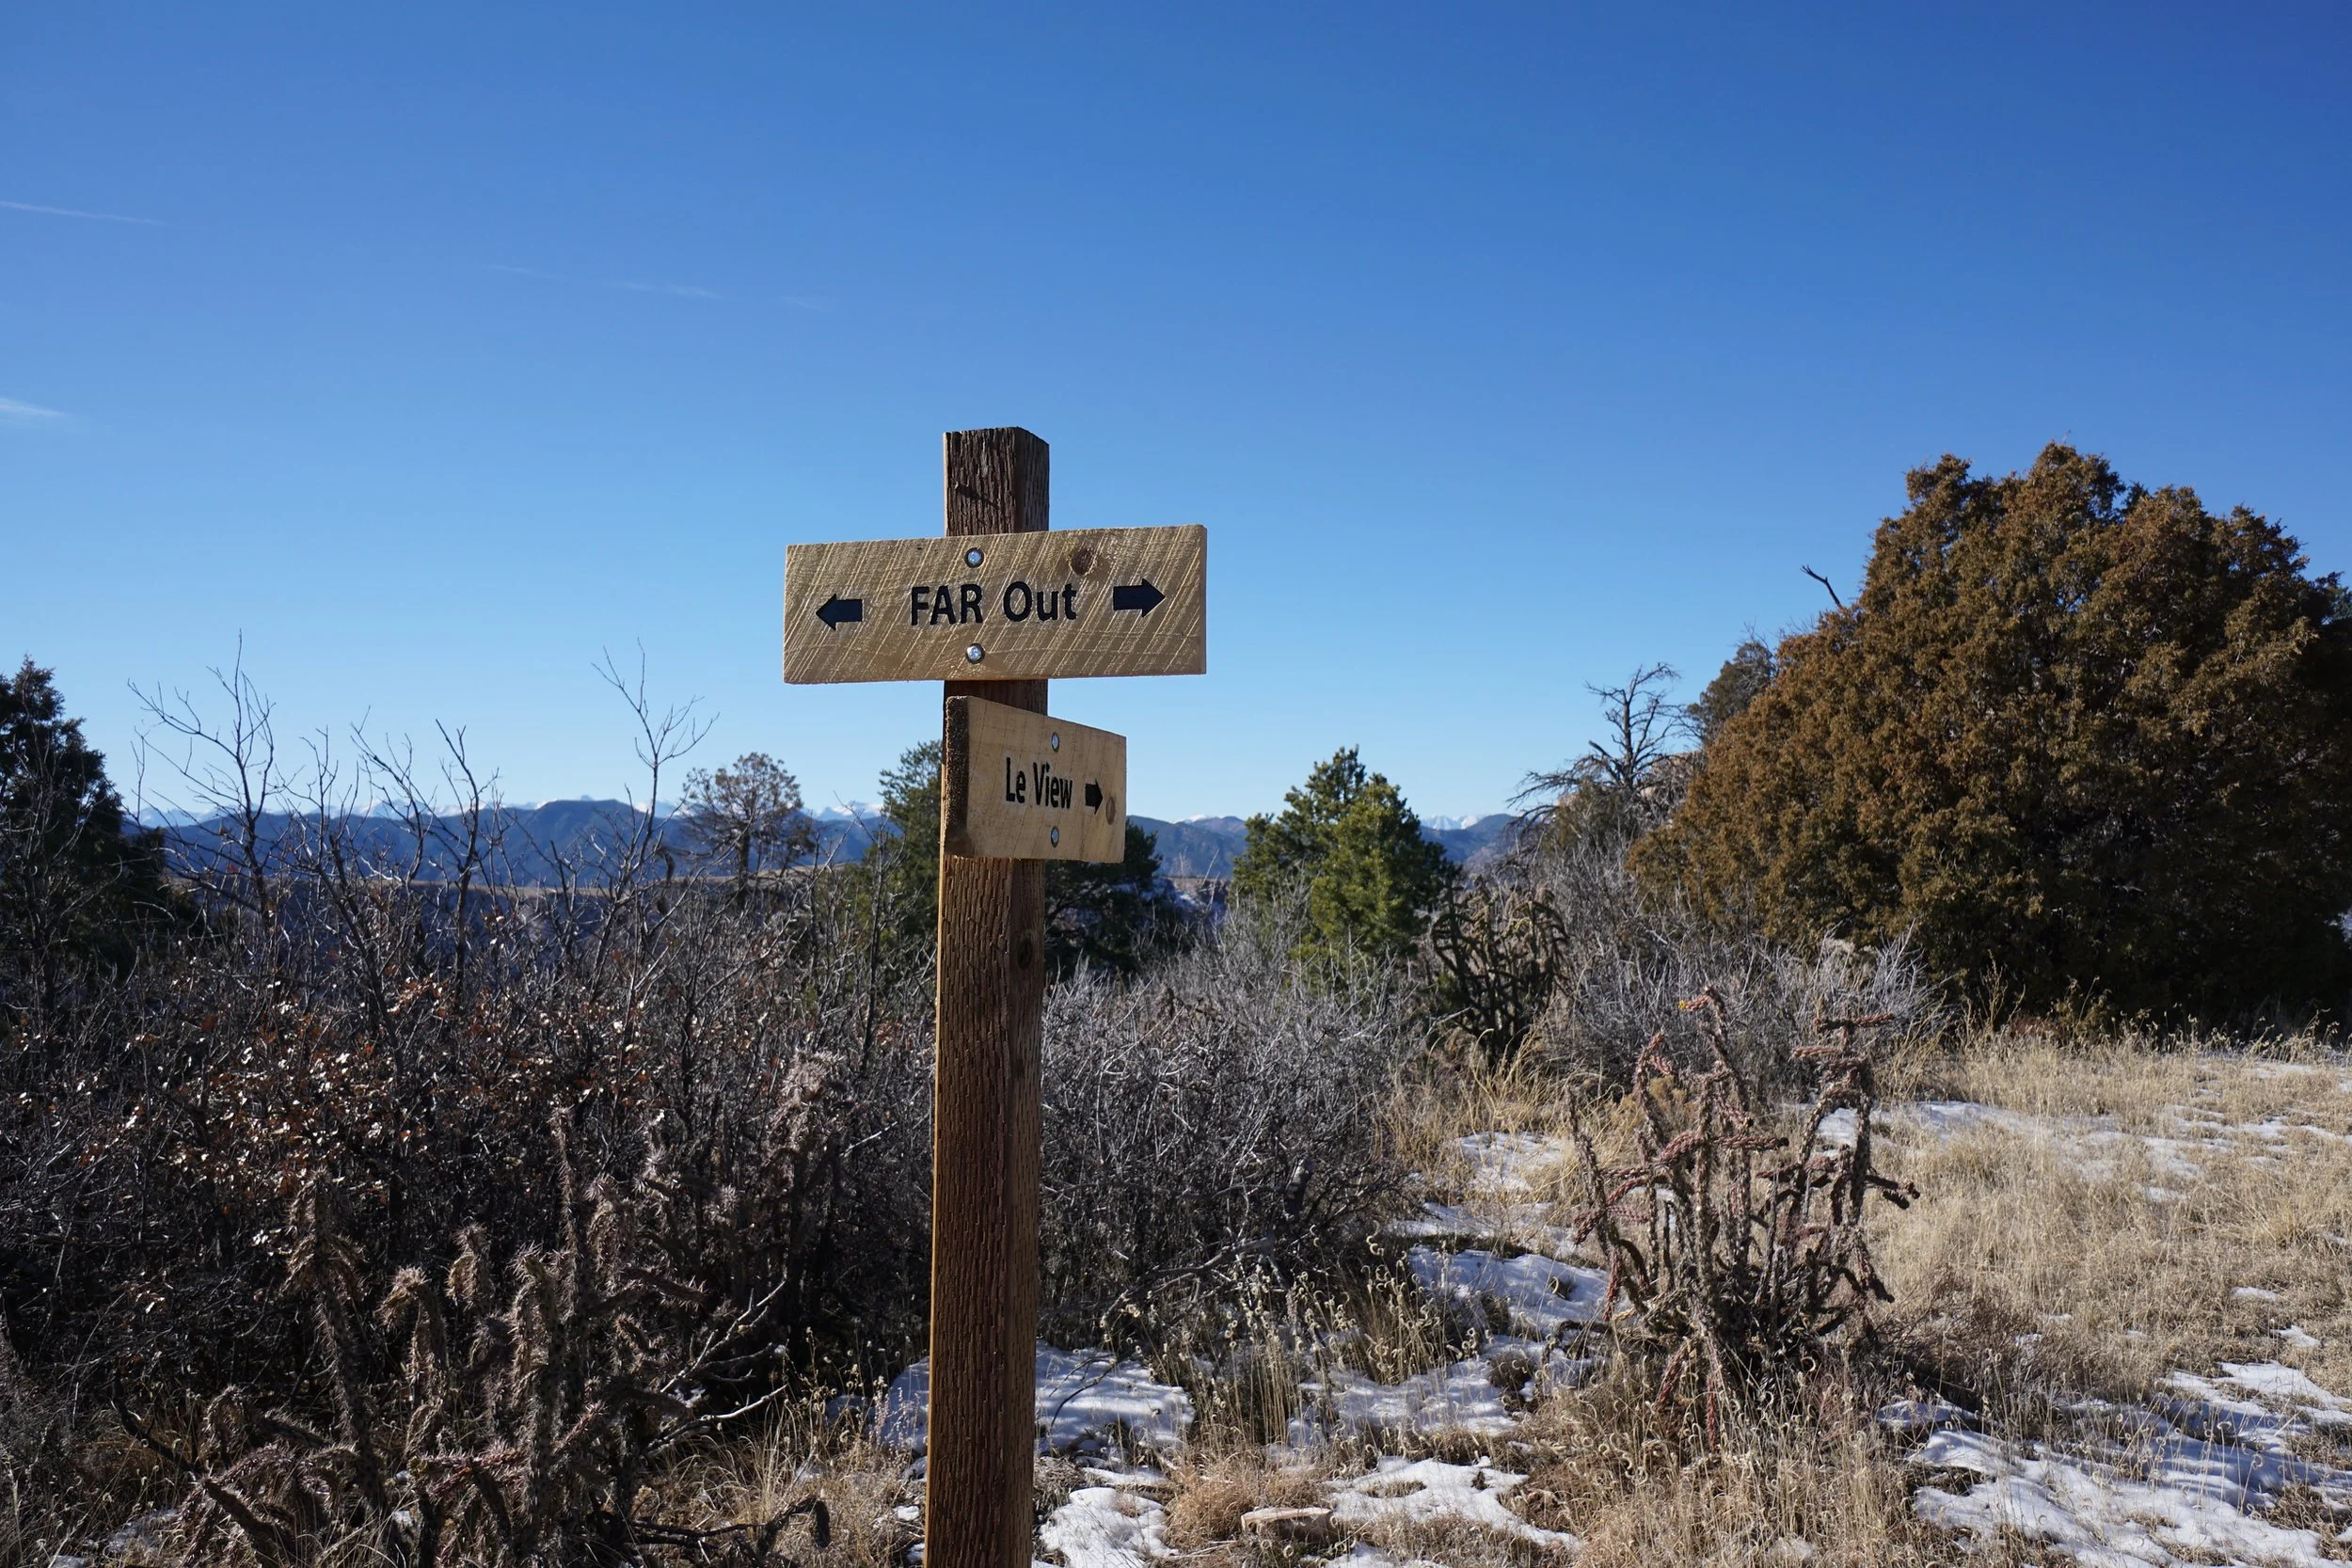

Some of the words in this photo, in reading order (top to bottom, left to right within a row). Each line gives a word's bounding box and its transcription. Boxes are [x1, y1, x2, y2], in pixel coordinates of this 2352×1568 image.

[910, 583, 983, 626] FAR
[1003, 581, 1077, 622] Out
[1006, 757, 1026, 803] Le
[1033, 761, 1073, 809] View
